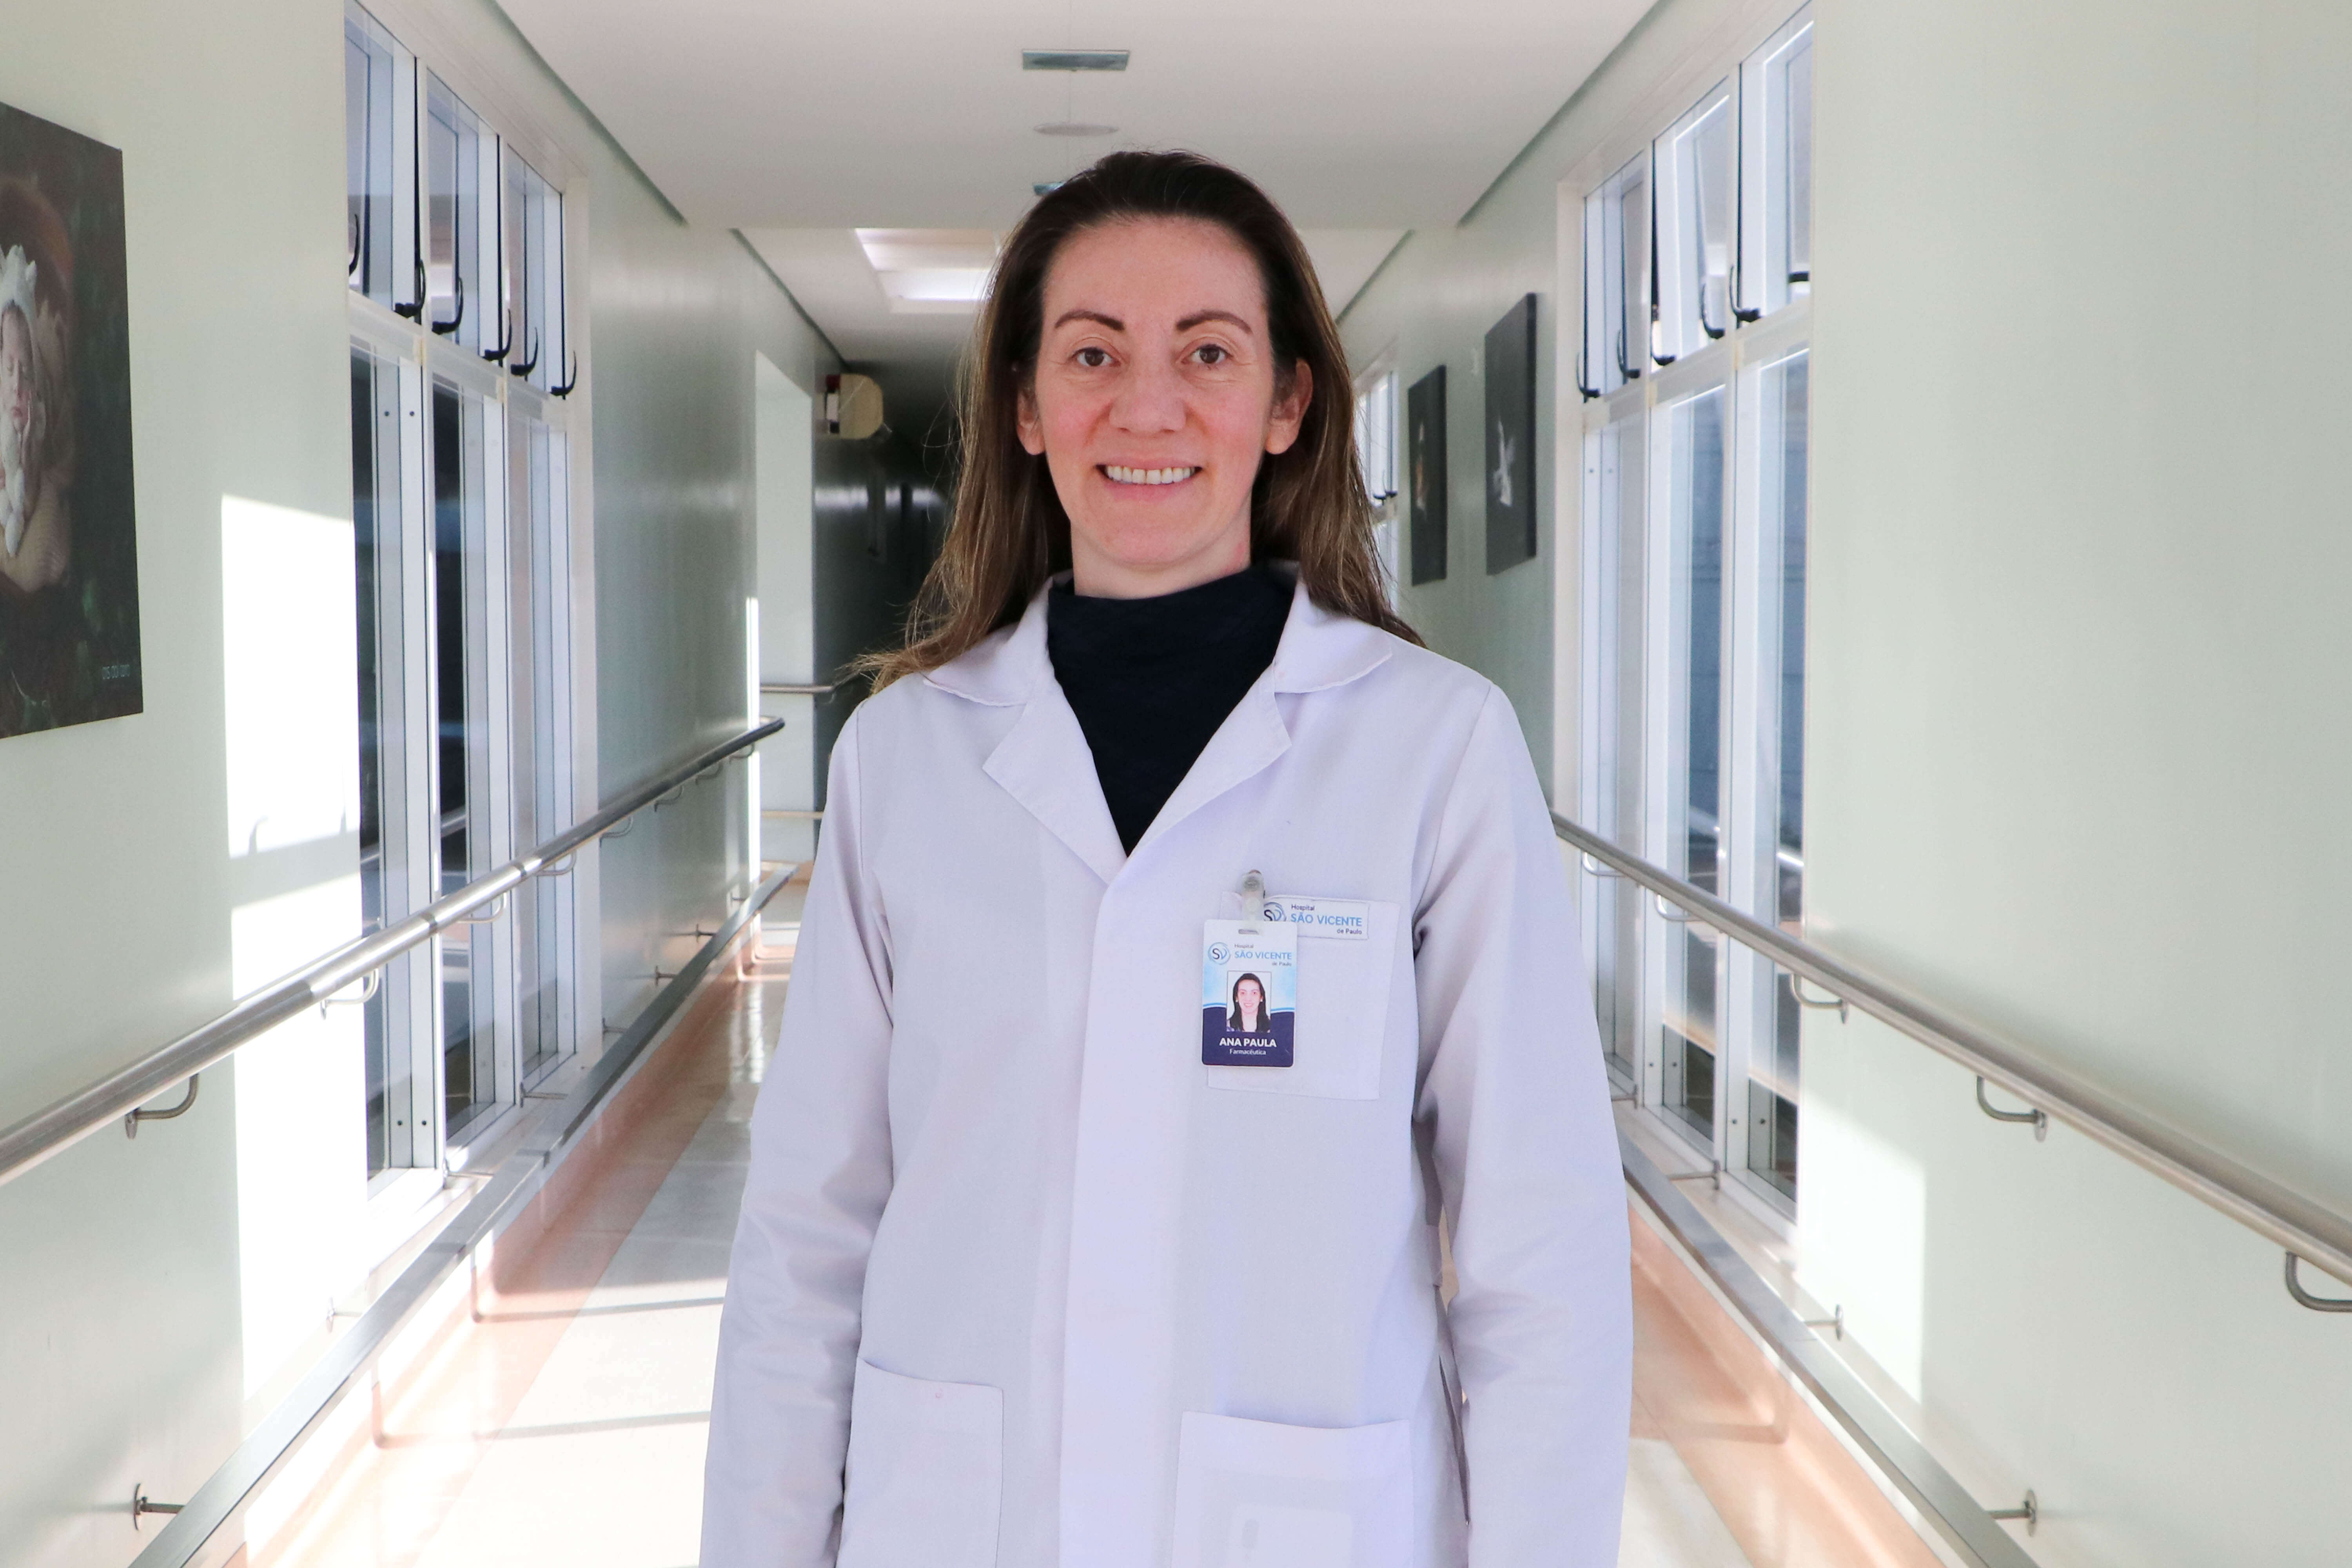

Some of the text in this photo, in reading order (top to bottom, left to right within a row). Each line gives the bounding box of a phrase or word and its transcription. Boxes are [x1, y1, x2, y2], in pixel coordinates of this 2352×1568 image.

[1291, 912, 1362, 926] SÃO VICENTE
[1235, 950, 1253, 958] SÃO
[1219, 1038, 1277, 1047] ANA PAULA
